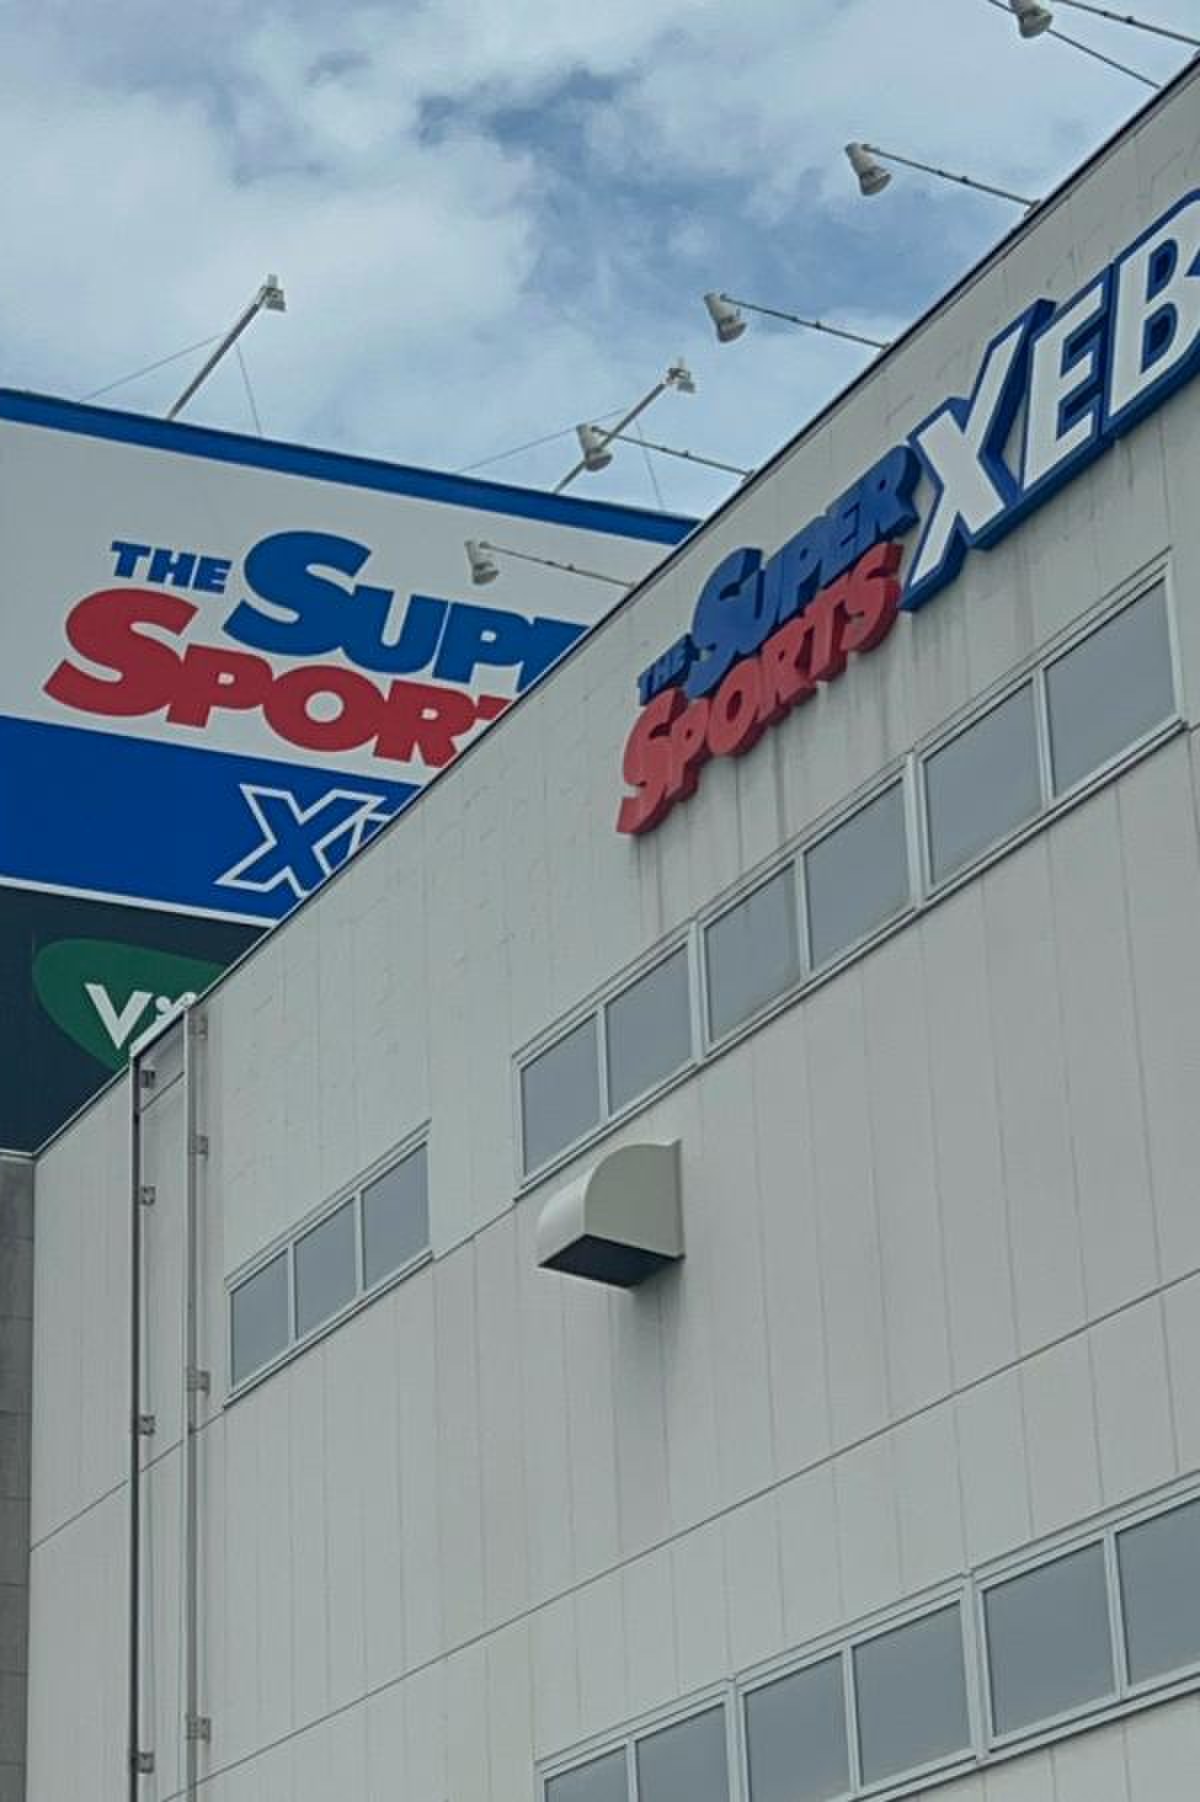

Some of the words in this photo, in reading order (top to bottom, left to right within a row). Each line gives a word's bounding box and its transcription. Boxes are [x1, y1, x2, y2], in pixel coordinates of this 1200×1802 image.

[111, 540, 233, 595] THE
[637, 633, 696, 706] THE
[688, 444, 922, 700] SUPER
[616, 542, 903, 833] SPORTS
[215, 783, 392, 899] X
